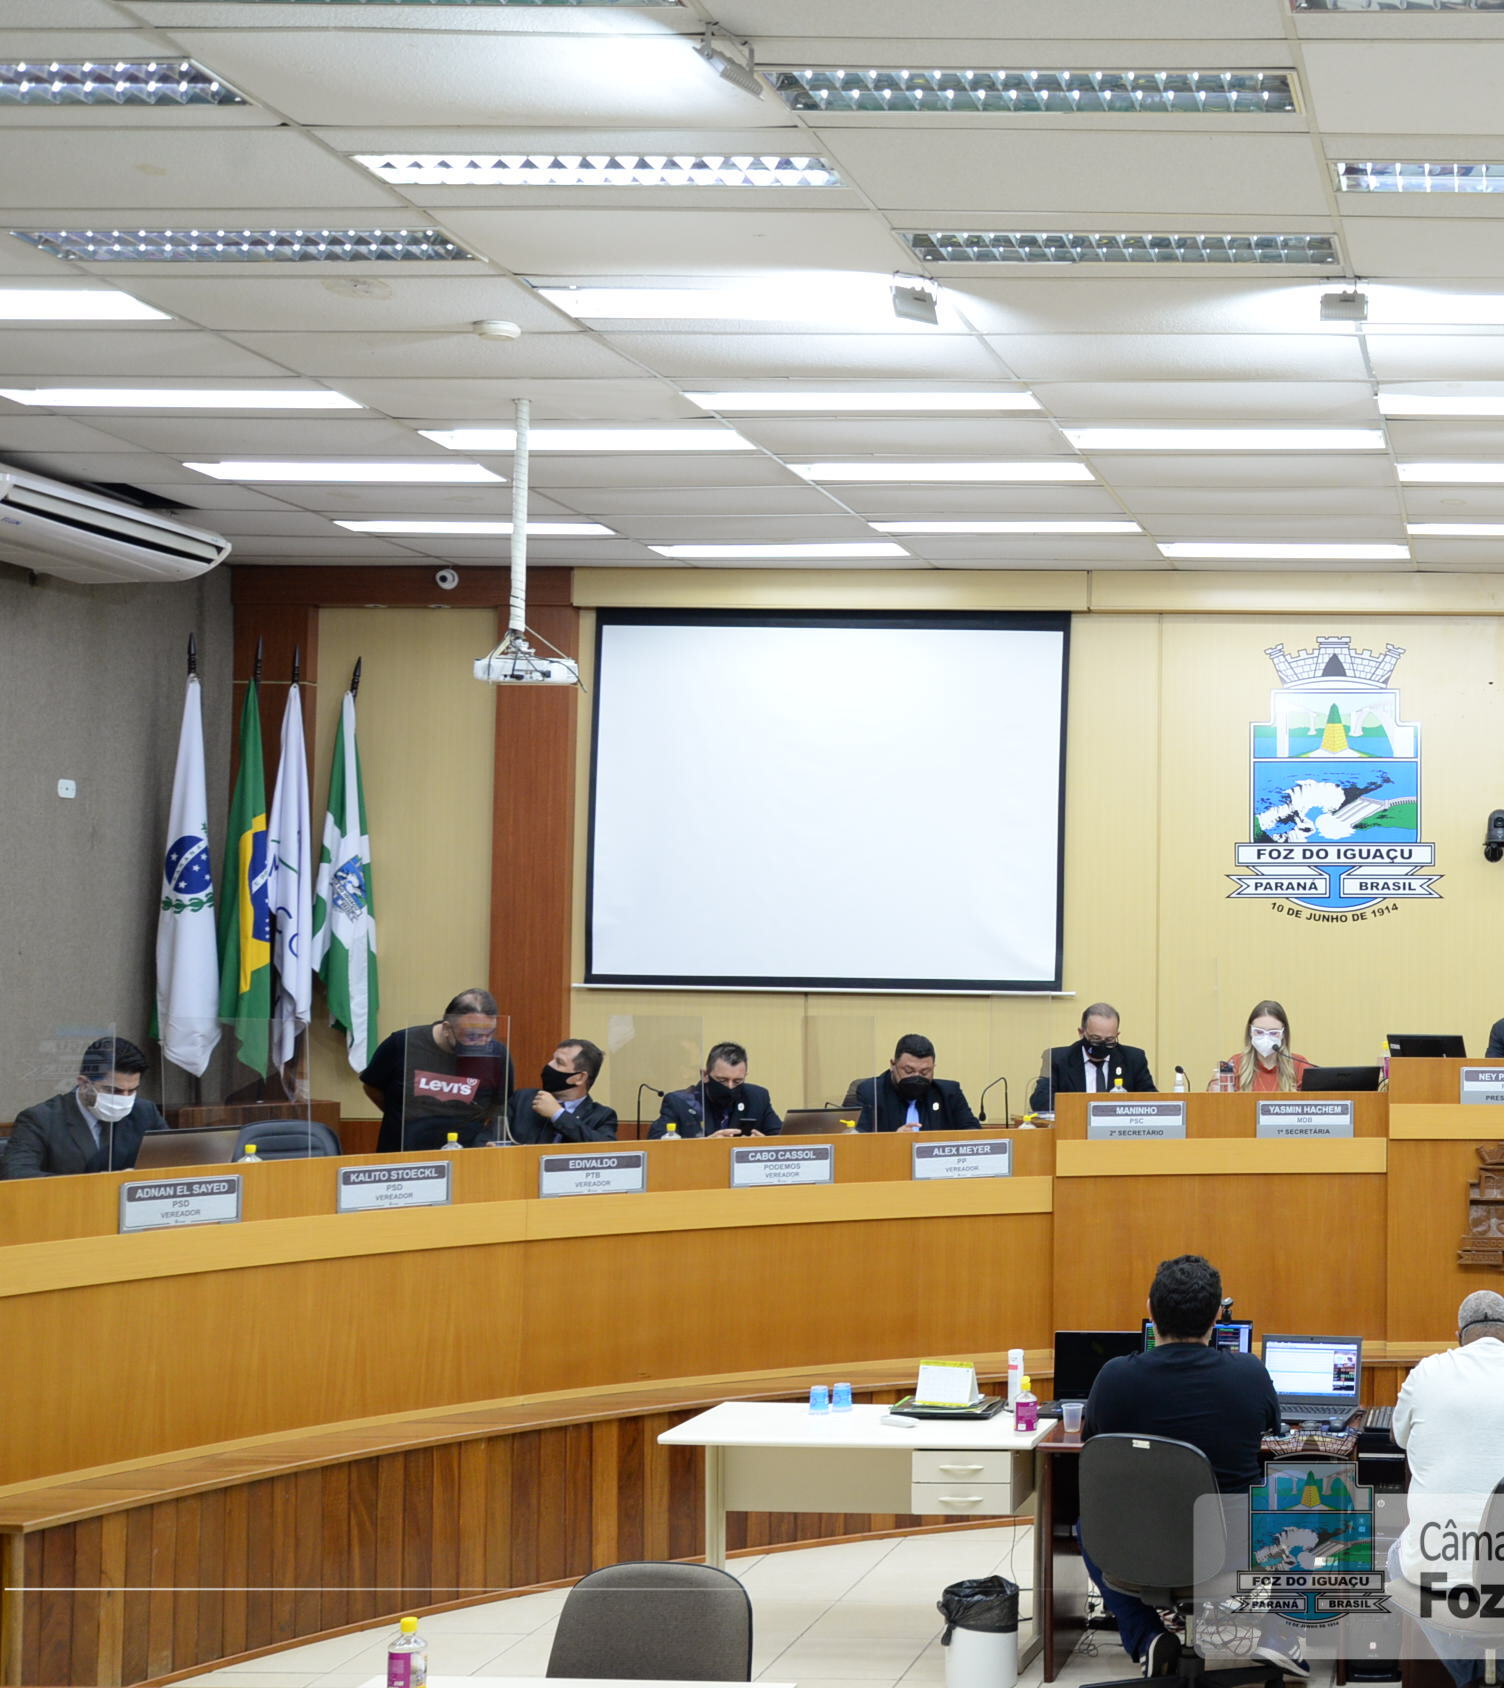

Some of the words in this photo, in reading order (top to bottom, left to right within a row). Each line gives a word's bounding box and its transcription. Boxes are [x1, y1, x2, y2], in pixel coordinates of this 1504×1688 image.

[1256, 848, 1296, 861] FOZ
[1302, 848, 1329, 861] DO
[1336, 848, 1413, 863] IGUAÇU
[1254, 878, 1319, 892] PARANÁ
[1359, 880, 1416, 892] BRASIL
[1271, 902, 1285, 913] 10
[1286, 907, 1302, 919] DE
[1305, 912, 1348, 923] JUNHO
[1351, 911, 1368, 922] DE
[1370, 903, 1399, 918] 1914
[1478, 1073, 1497, 1081] NEY
[1116, 1106, 1158, 1115] MANINHO
[1268, 1105, 1302, 1114] YASMIN
[1303, 1105, 1342, 1114] HACHEM
[748, 1152, 776, 1161] CABO
[777, 1150, 816, 1160] CASSOL
[933, 1147, 957, 1156] ALEX
[959, 1145, 991, 1154] MEYER
[569, 1158, 618, 1169] EDIVALDO
[763, 1163, 801, 1171] PODEMOS
[350, 1171, 389, 1183] KALITO
[390, 1168, 438, 1180] STOECKL
[386, 1183, 404, 1192] PSD
[575, 1180, 611, 1188] VEREADOR
[135, 1186, 174, 1199] ADNAN
[176, 1185, 191, 1195] EL
[192, 1182, 229, 1194] SAYED
[376, 1192, 413, 1201] VEREADOR
[160, 1209, 201, 1219] VEREADOR
